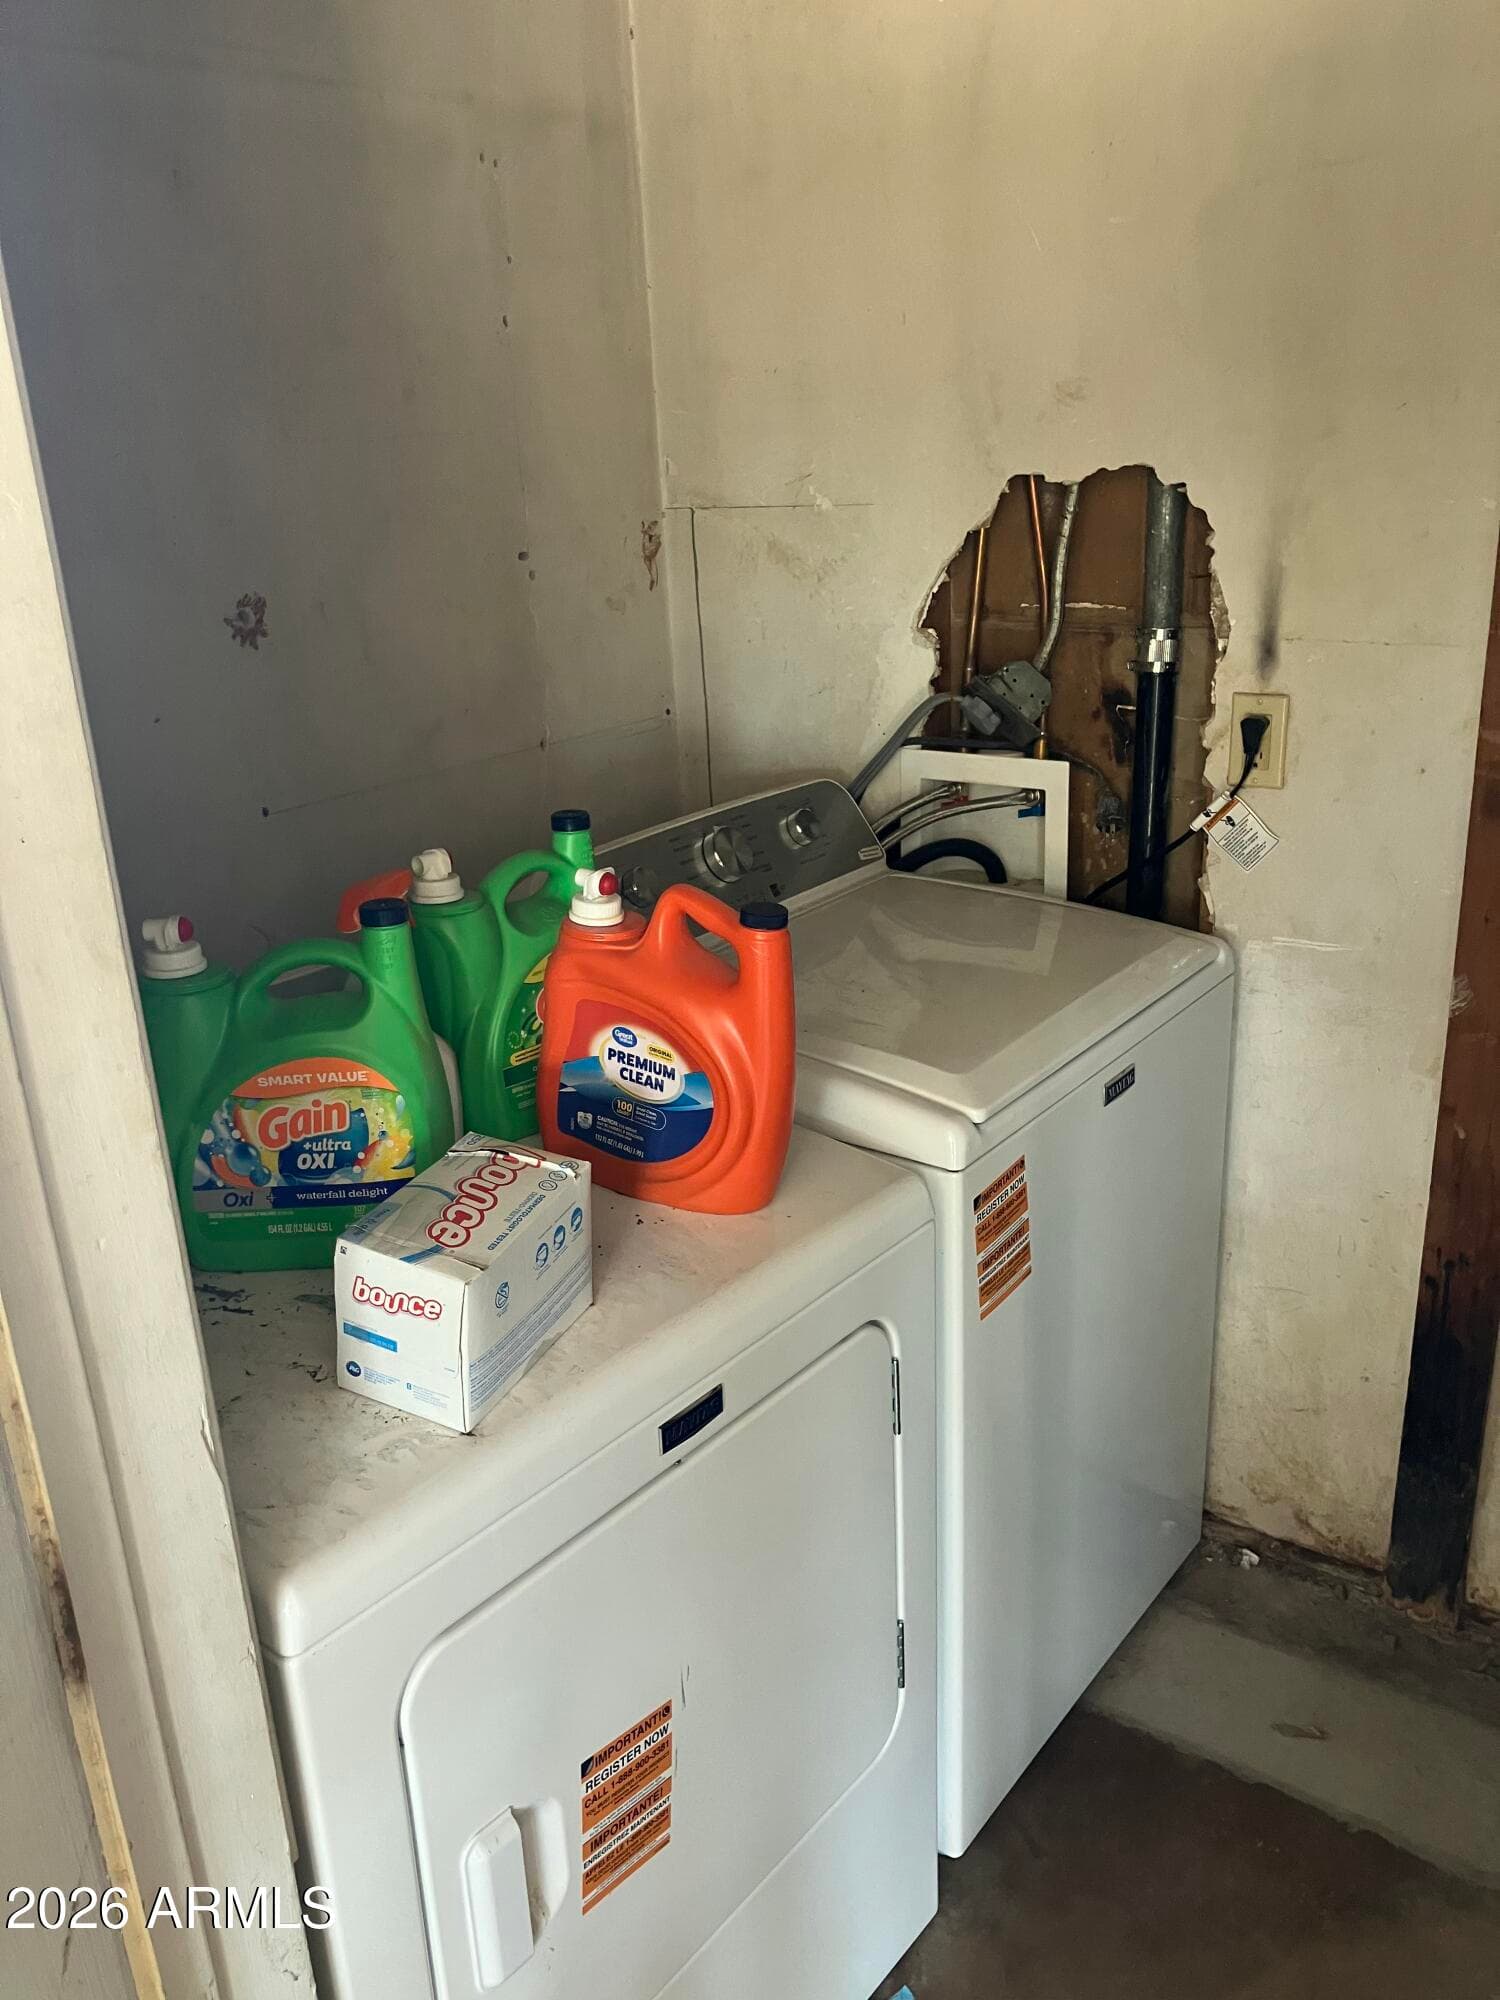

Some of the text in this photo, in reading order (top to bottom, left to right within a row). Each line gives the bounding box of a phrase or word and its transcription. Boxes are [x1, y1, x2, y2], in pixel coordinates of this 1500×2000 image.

[607, 1047, 676, 1081] PREMIUM
[649, 1046, 673, 1059] ORIGINAL
[257, 1070, 369, 1088] SMART VALUE
[619, 1067, 665, 1093] CLEAN
[617, 1099, 633, 1112] 100
[257, 1099, 349, 1150] Gain
[297, 1152, 336, 1170] OXI
[303, 1138, 352, 1151] +ultra
[223, 1191, 254, 1208] Oxi
[296, 1189, 346, 1201] waterfall
[348, 1186, 388, 1200] delight
[427, 1146, 547, 1248] bounce
[976, 1190, 1009, 1223] REGISTER
[1009, 1174, 1026, 1197] NOW
[487, 1194, 546, 1251] DERMATOLOGIST TESTED
[352, 1276, 443, 1321] bounce
[585, 1744, 642, 1794] REGISTER
[643, 1723, 670, 1750] NOW
[584, 1787, 609, 1809] CALL
[583, 1829, 629, 1870] ENREGISTREZ
[630, 1795, 671, 1833] MAINTENANT
[590, 1788, 664, 1853] IMPORTANTE!
